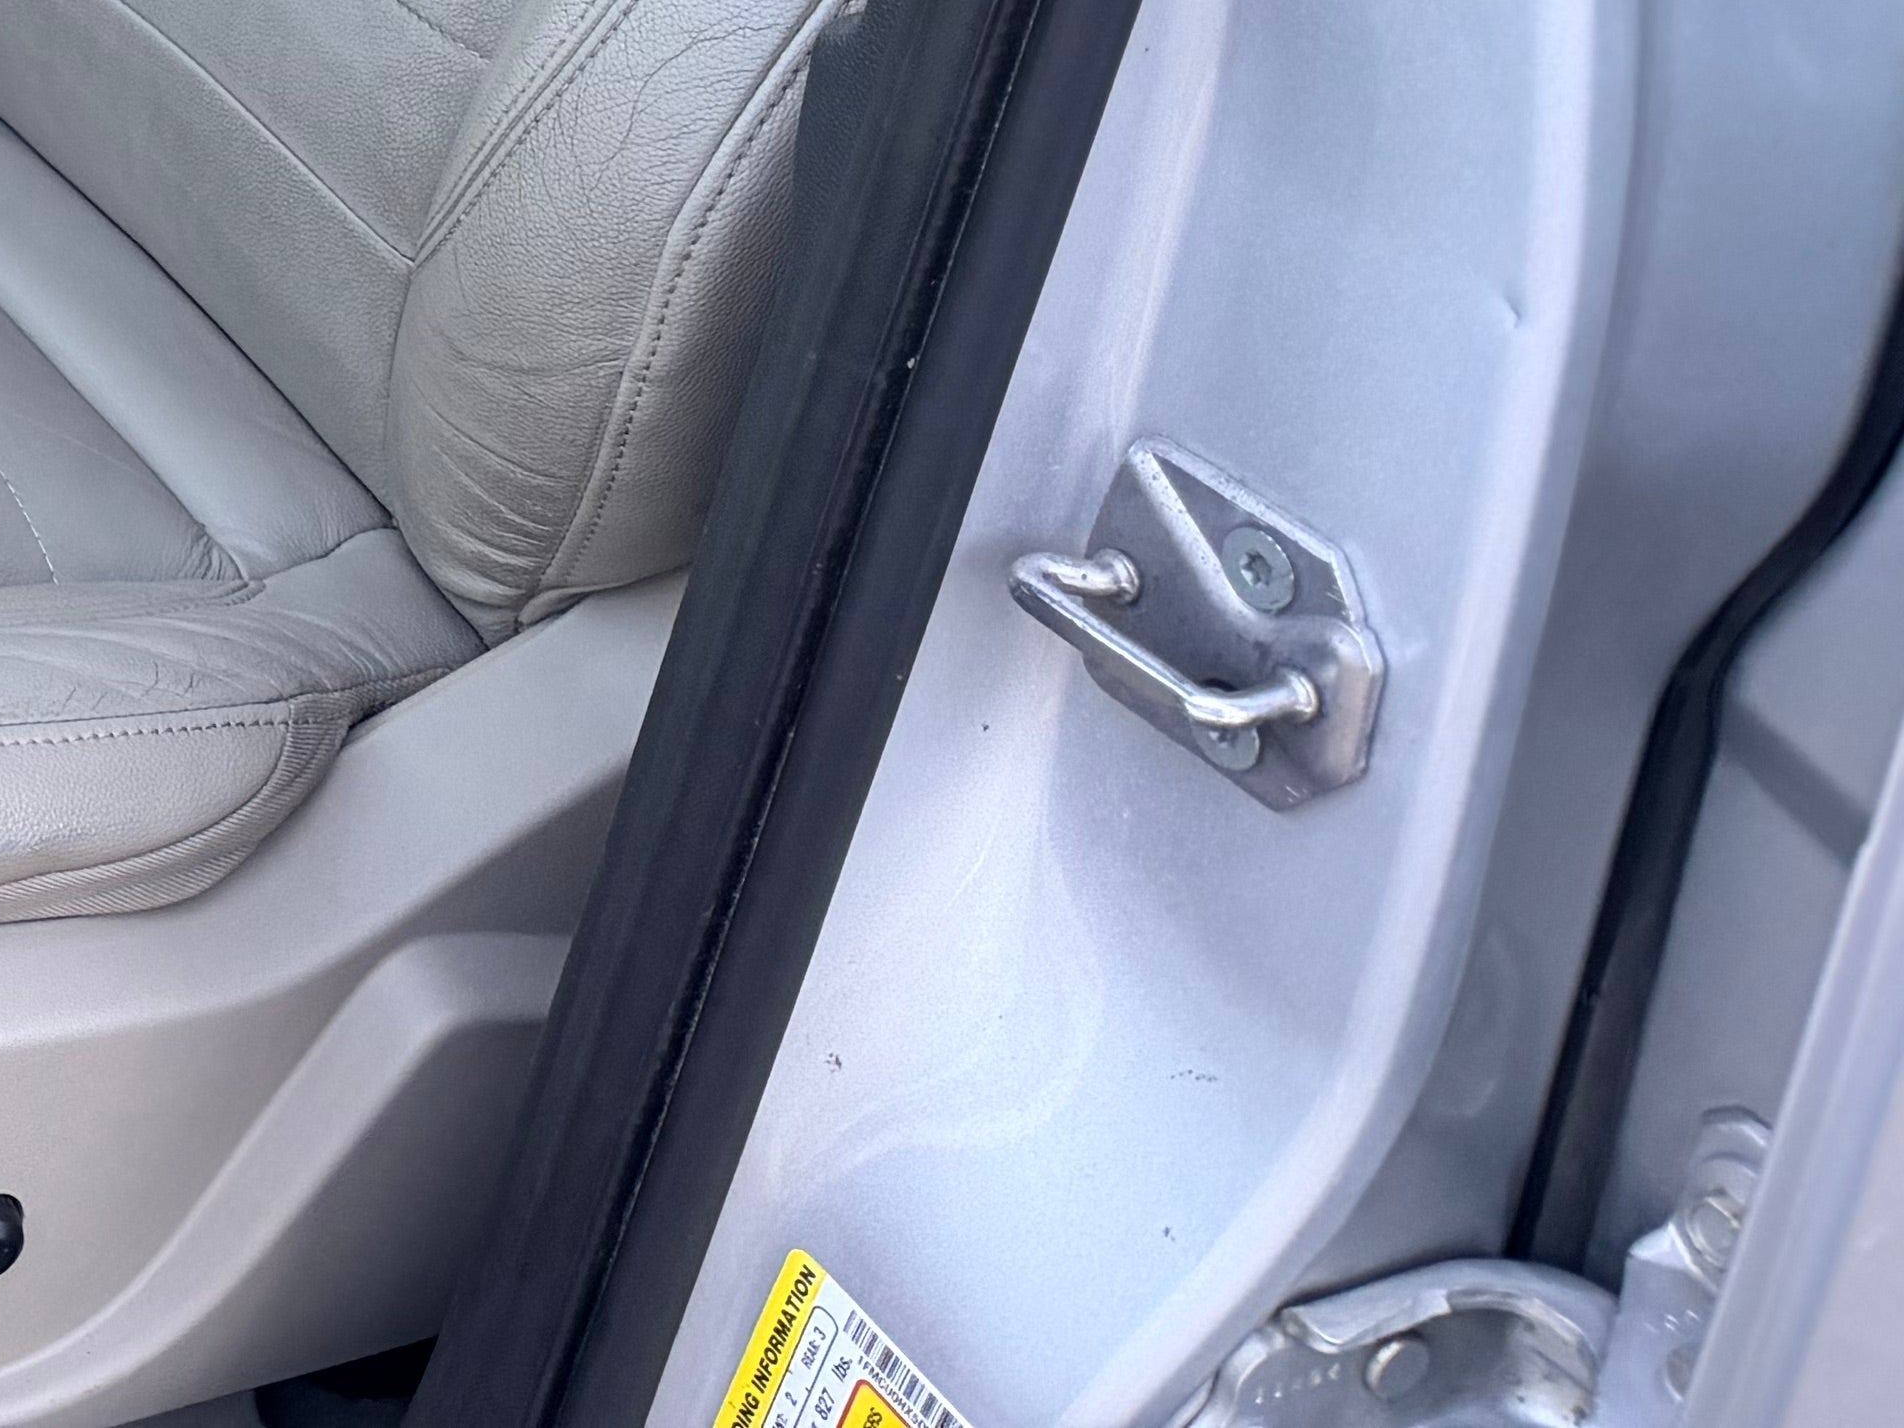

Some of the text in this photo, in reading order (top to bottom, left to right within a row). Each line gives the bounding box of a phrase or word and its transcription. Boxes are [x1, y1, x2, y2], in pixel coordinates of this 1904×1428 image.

[751, 1264, 816, 1394] INFORMATION
[813, 1326, 827, 1340] 3
[814, 1356, 853, 1421] 827 lbs.
